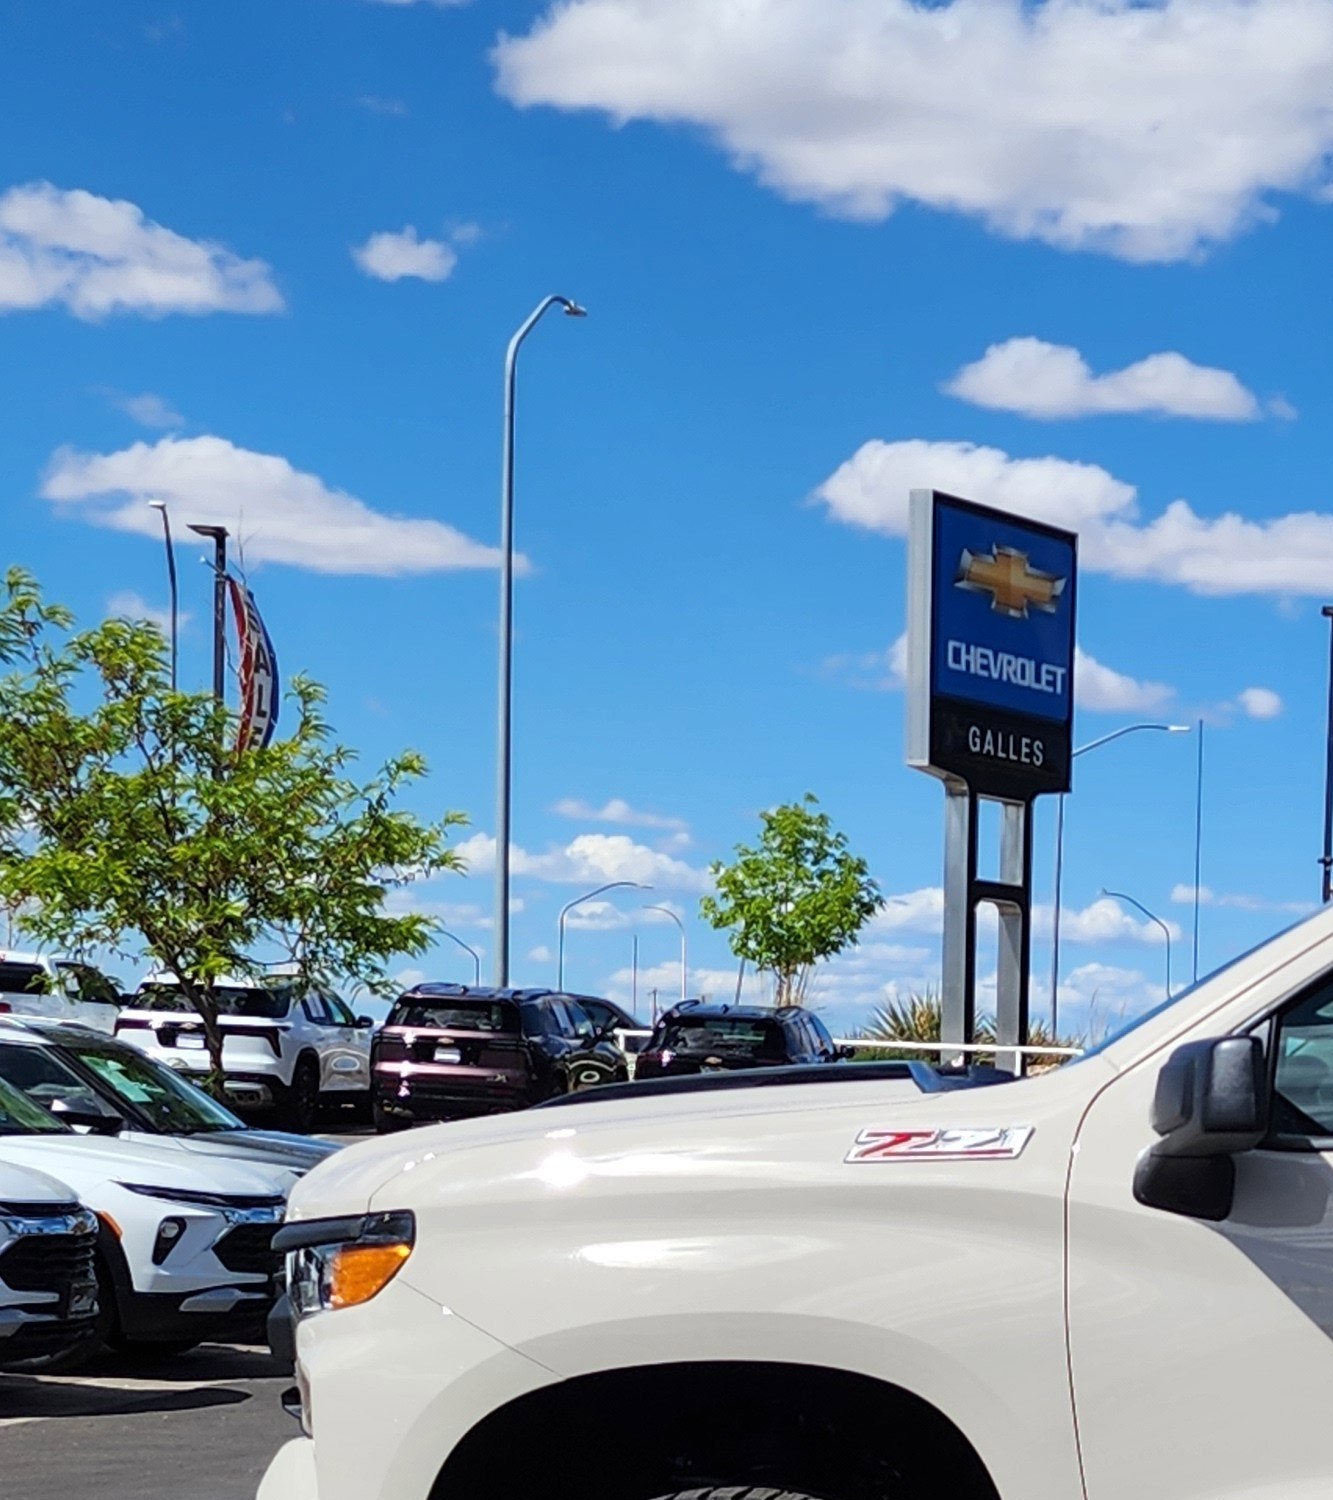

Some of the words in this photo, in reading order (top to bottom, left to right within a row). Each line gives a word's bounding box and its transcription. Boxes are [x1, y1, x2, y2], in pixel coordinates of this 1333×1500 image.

[947, 639, 1066, 695] CHEVROLET
[968, 725, 1044, 767] GALLES
[843, 1126, 1036, 1164] Z71
